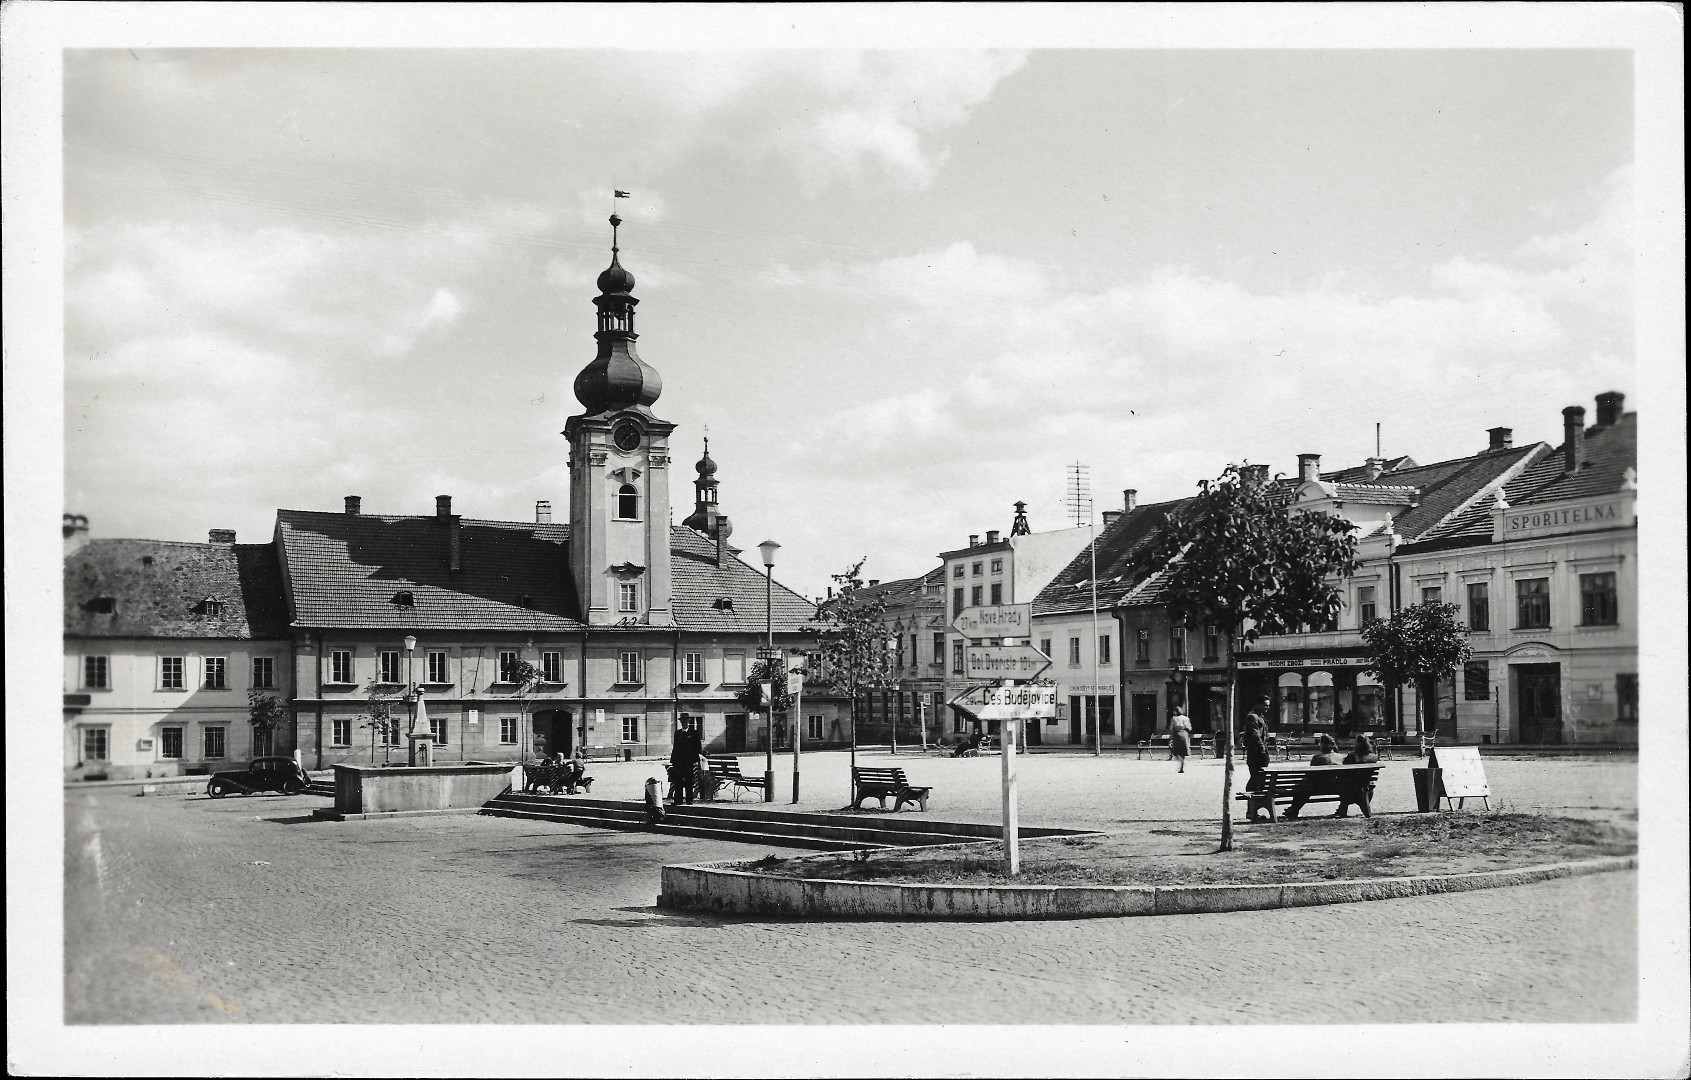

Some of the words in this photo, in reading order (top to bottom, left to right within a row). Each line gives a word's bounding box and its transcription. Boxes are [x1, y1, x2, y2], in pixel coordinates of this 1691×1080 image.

[1512, 505, 1616, 530] SPOŘITELNA
[998, 608, 1022, 626] Hrady
[1004, 689, 1055, 709] Budějovice
